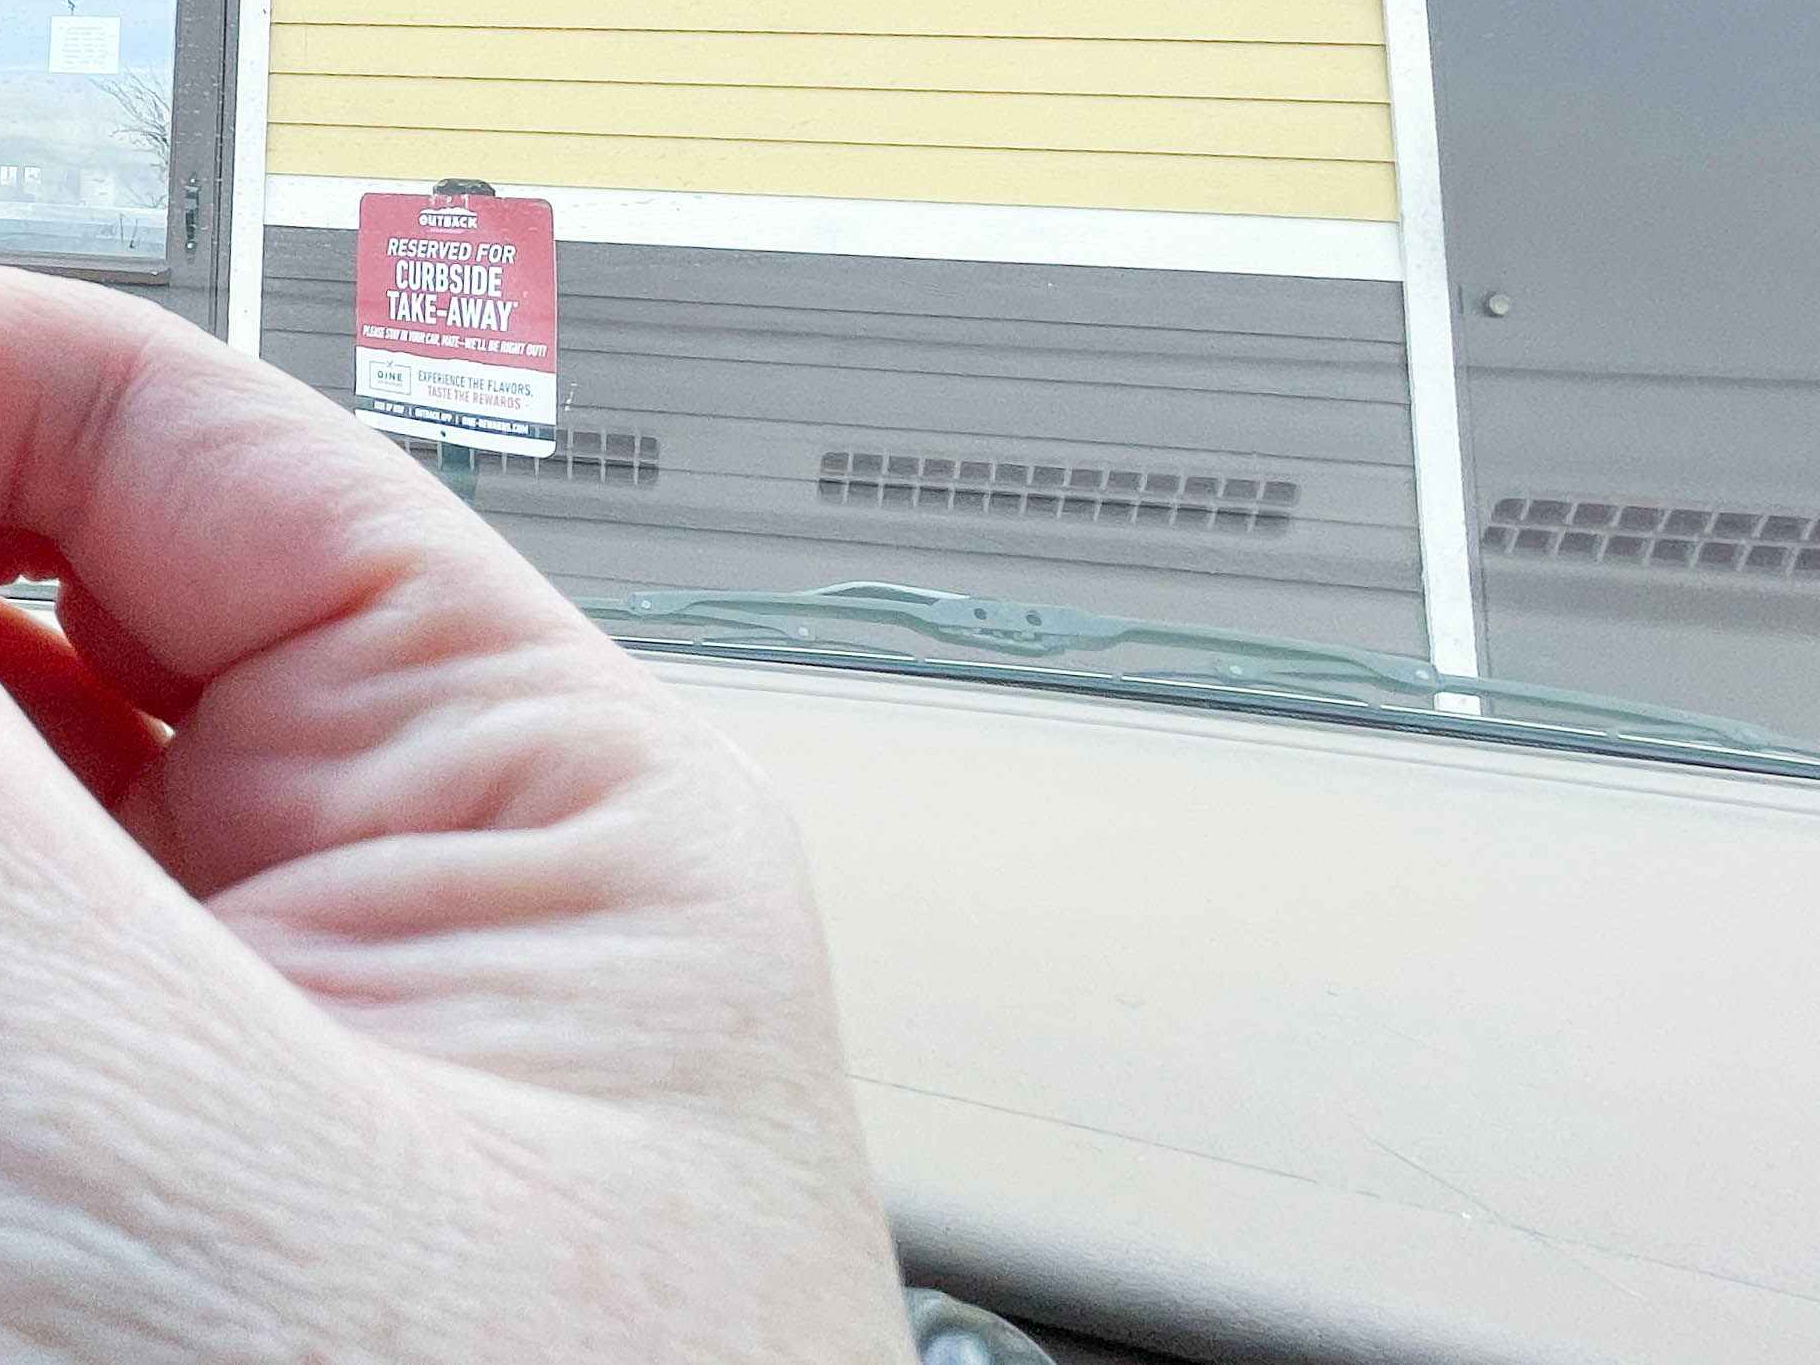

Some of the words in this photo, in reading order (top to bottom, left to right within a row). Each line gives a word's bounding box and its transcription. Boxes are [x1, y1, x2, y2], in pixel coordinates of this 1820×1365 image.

[418, 214, 478, 229] OUTBACK
[387, 238, 472, 261] RESERVED
[476, 243, 517, 264] FOR
[395, 259, 503, 298] CURBSIDE
[418, 369, 466, 388] EXPERIENCE
[468, 376, 485, 391] THE
[427, 385, 452, 401] TASTE
[454, 389, 470, 404] THE
